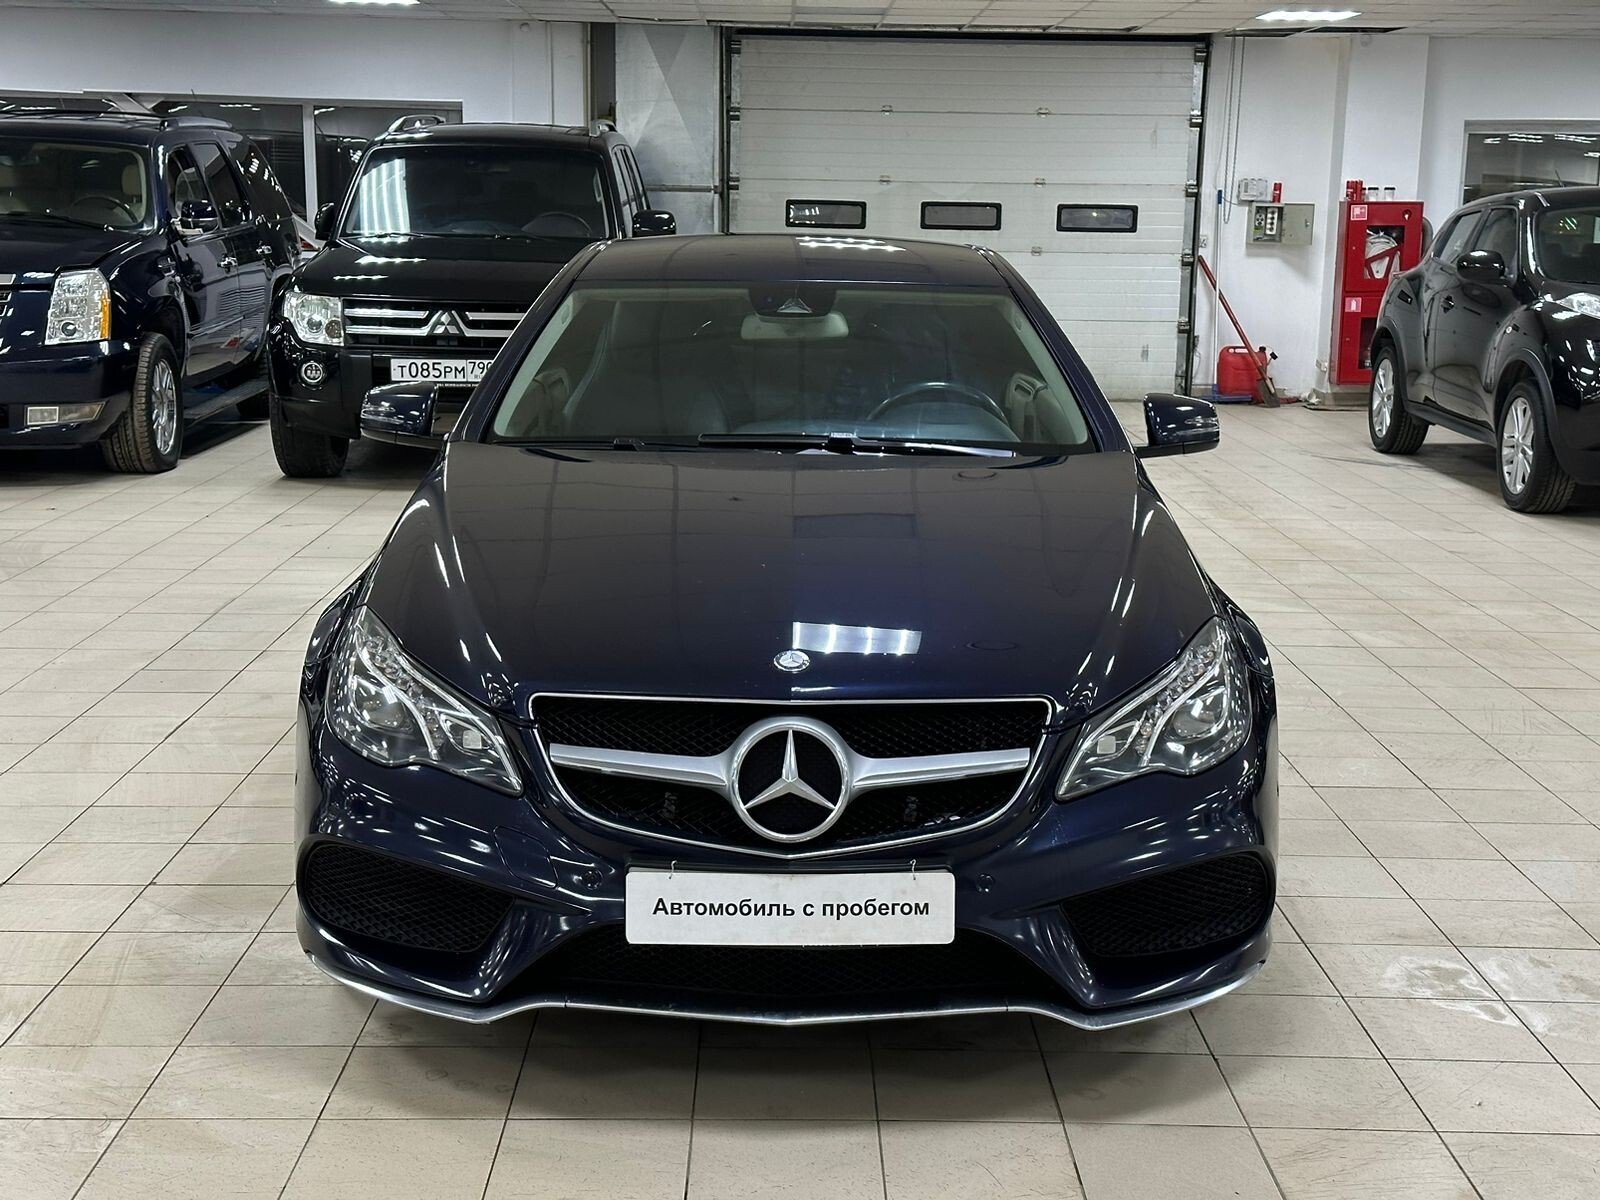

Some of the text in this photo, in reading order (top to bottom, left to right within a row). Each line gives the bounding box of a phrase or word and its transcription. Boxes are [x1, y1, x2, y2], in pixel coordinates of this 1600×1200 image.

[652, 897, 930, 921] Автомобиль с пробегом
